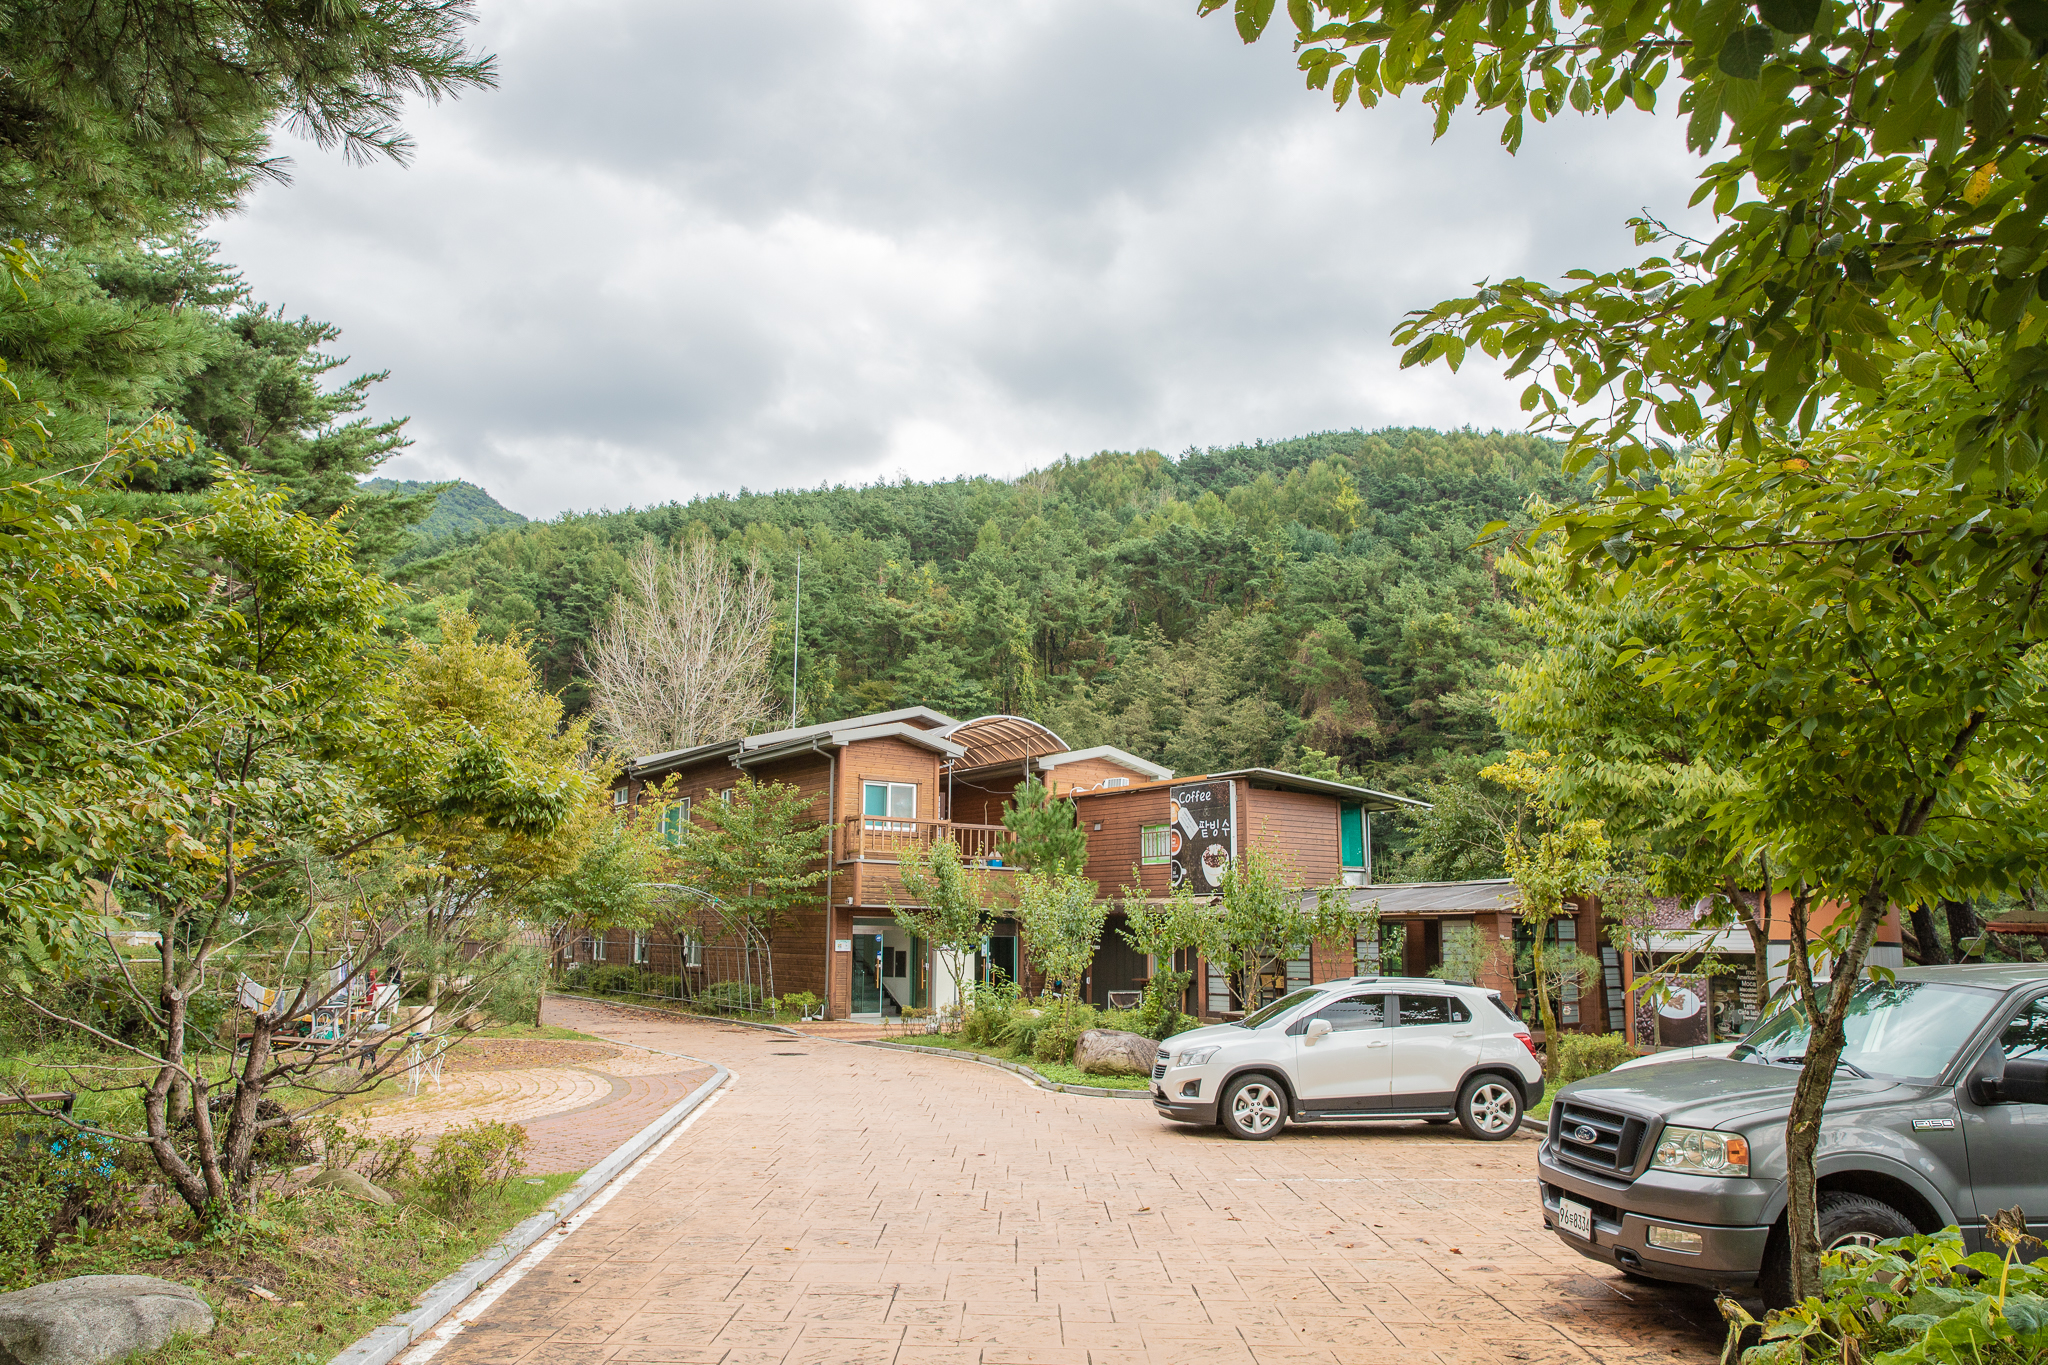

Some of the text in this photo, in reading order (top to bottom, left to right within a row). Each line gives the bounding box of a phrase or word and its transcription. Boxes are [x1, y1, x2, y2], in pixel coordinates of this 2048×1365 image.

[1179, 790, 1211, 804] Coffee
[1199, 818, 1230, 838] 팥빙수
[1577, 1128, 1591, 1140] Ford
